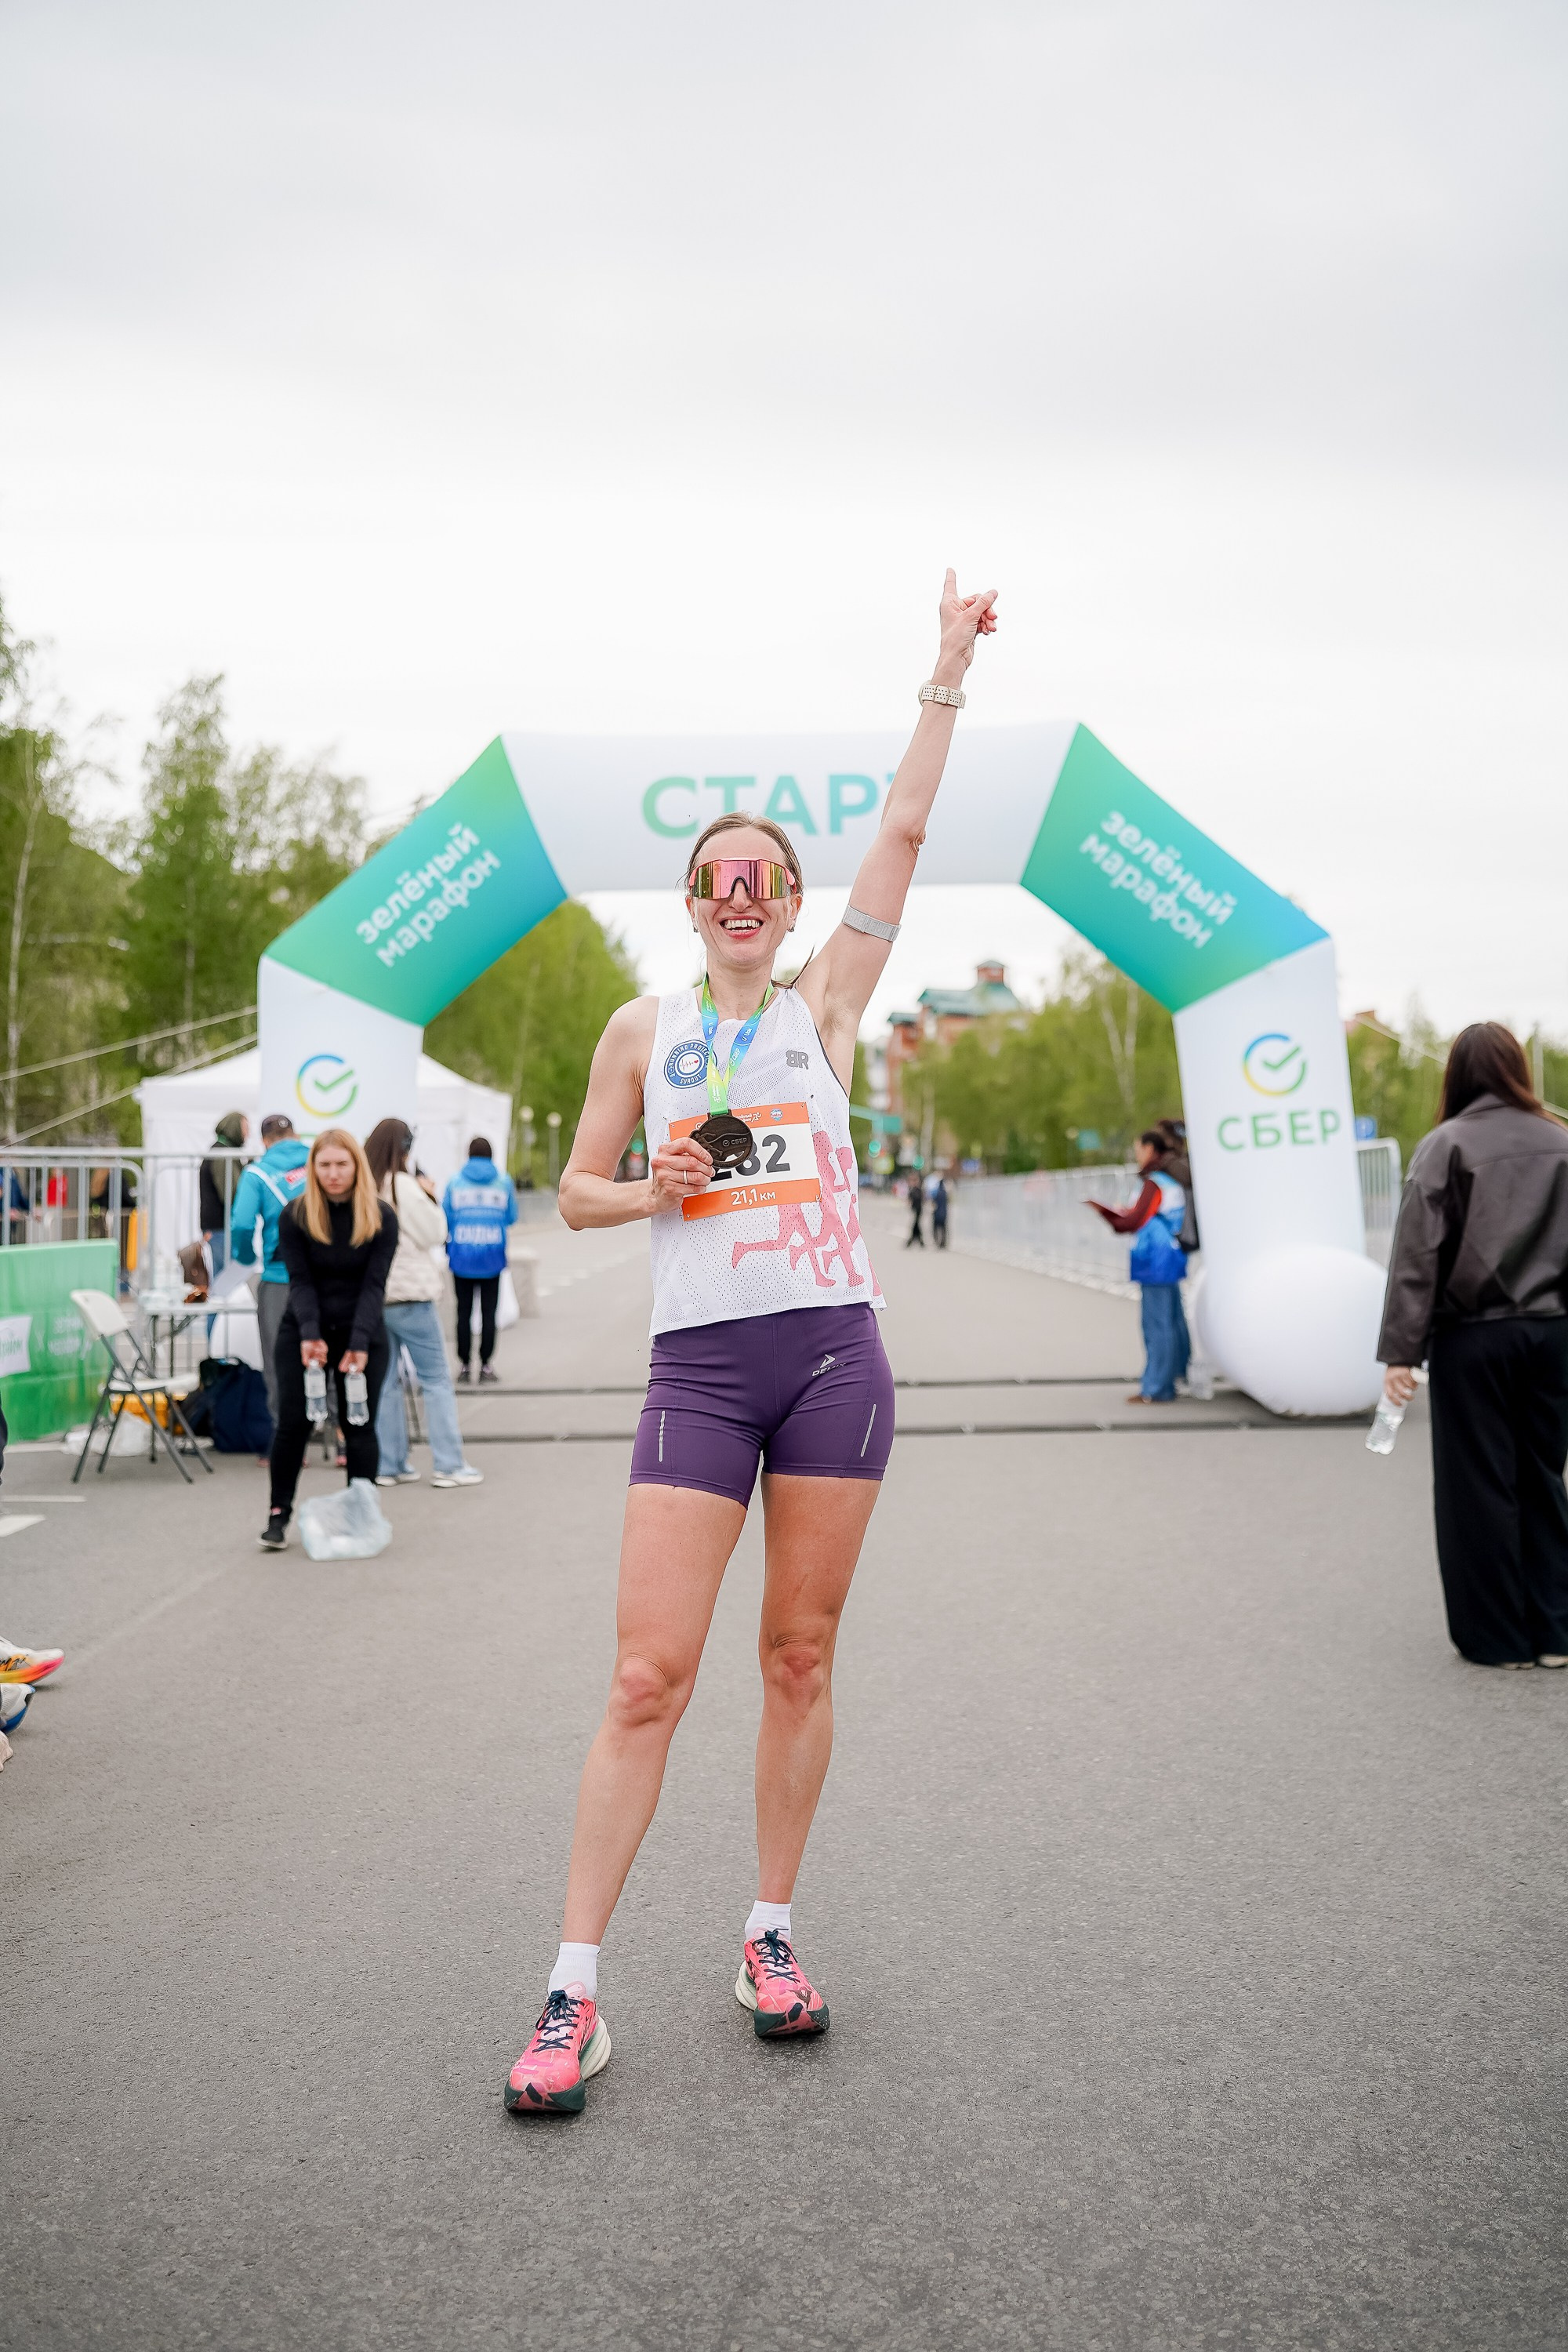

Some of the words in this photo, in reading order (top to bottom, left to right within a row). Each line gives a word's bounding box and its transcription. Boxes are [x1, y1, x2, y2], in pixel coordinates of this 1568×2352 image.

[641, 772, 896, 839] СТАР
[355, 822, 481, 945] зелёный
[376, 849, 502, 967] марафон
[1079, 833, 1214, 949] марафон
[1100, 811, 1238, 925] зелёный
[1217, 1109, 1341, 1151] СБЕР
[731, 1188, 758, 1206] 21,1
